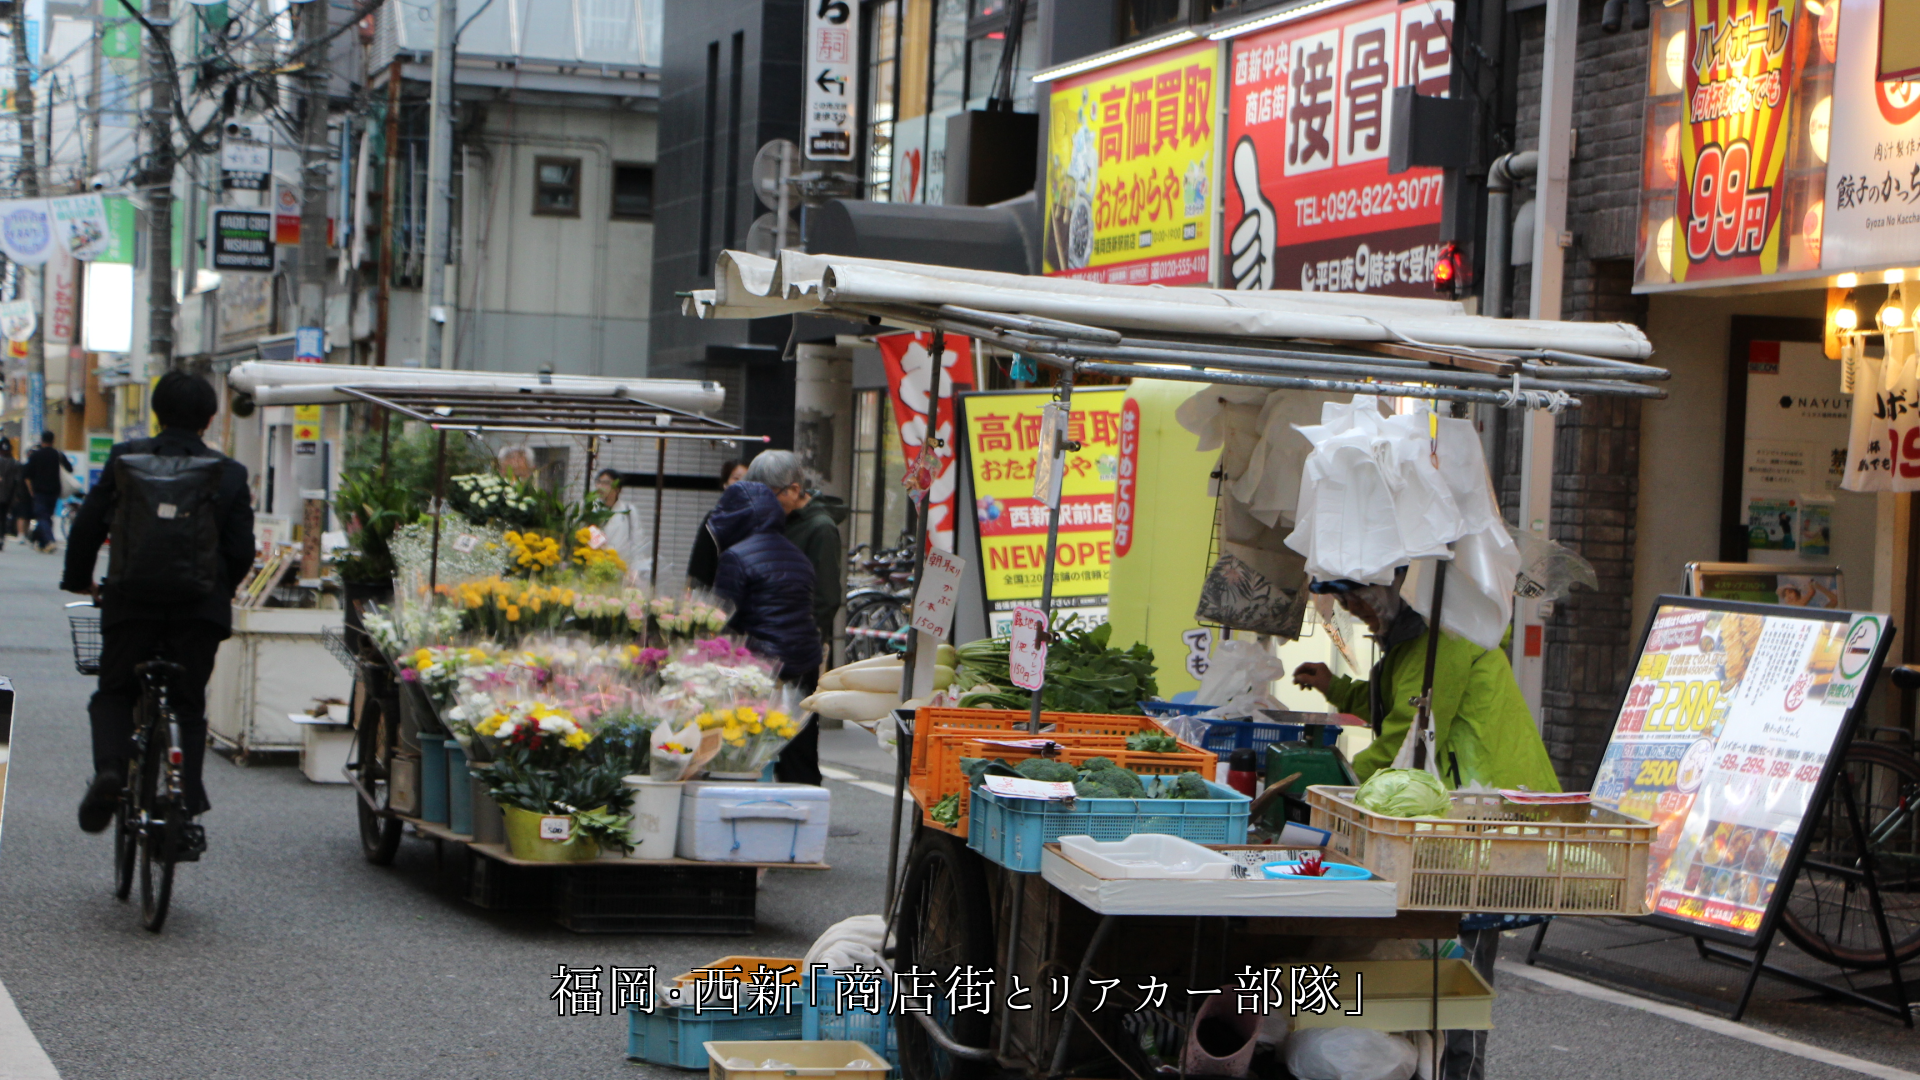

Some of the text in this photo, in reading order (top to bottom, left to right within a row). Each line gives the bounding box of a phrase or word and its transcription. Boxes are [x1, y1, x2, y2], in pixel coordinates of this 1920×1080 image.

[1235, 42, 1288, 85] 西新中央
[1694, 9, 1787, 75] ハイボール
[1099, 63, 1212, 167] 高価買取
[1245, 84, 1286, 126] 商店街
[1690, 70, 1780, 123] 何杯飲んでも
[1095, 167, 1181, 231] おたからや
[1295, 174, 1443, 227] TEL:092-822-3077
[1687, 139, 1770, 263] 99円
[1866, 216, 1884, 231] Gyoza
[1886, 213, 1895, 226] No
[981, 456, 1092, 481] おたや
[1113, 411, 1137, 547] はじめての方
[1004, 570, 1110, 585] 全国120店舗の信頼と
[915, 616, 944, 637] 150円
